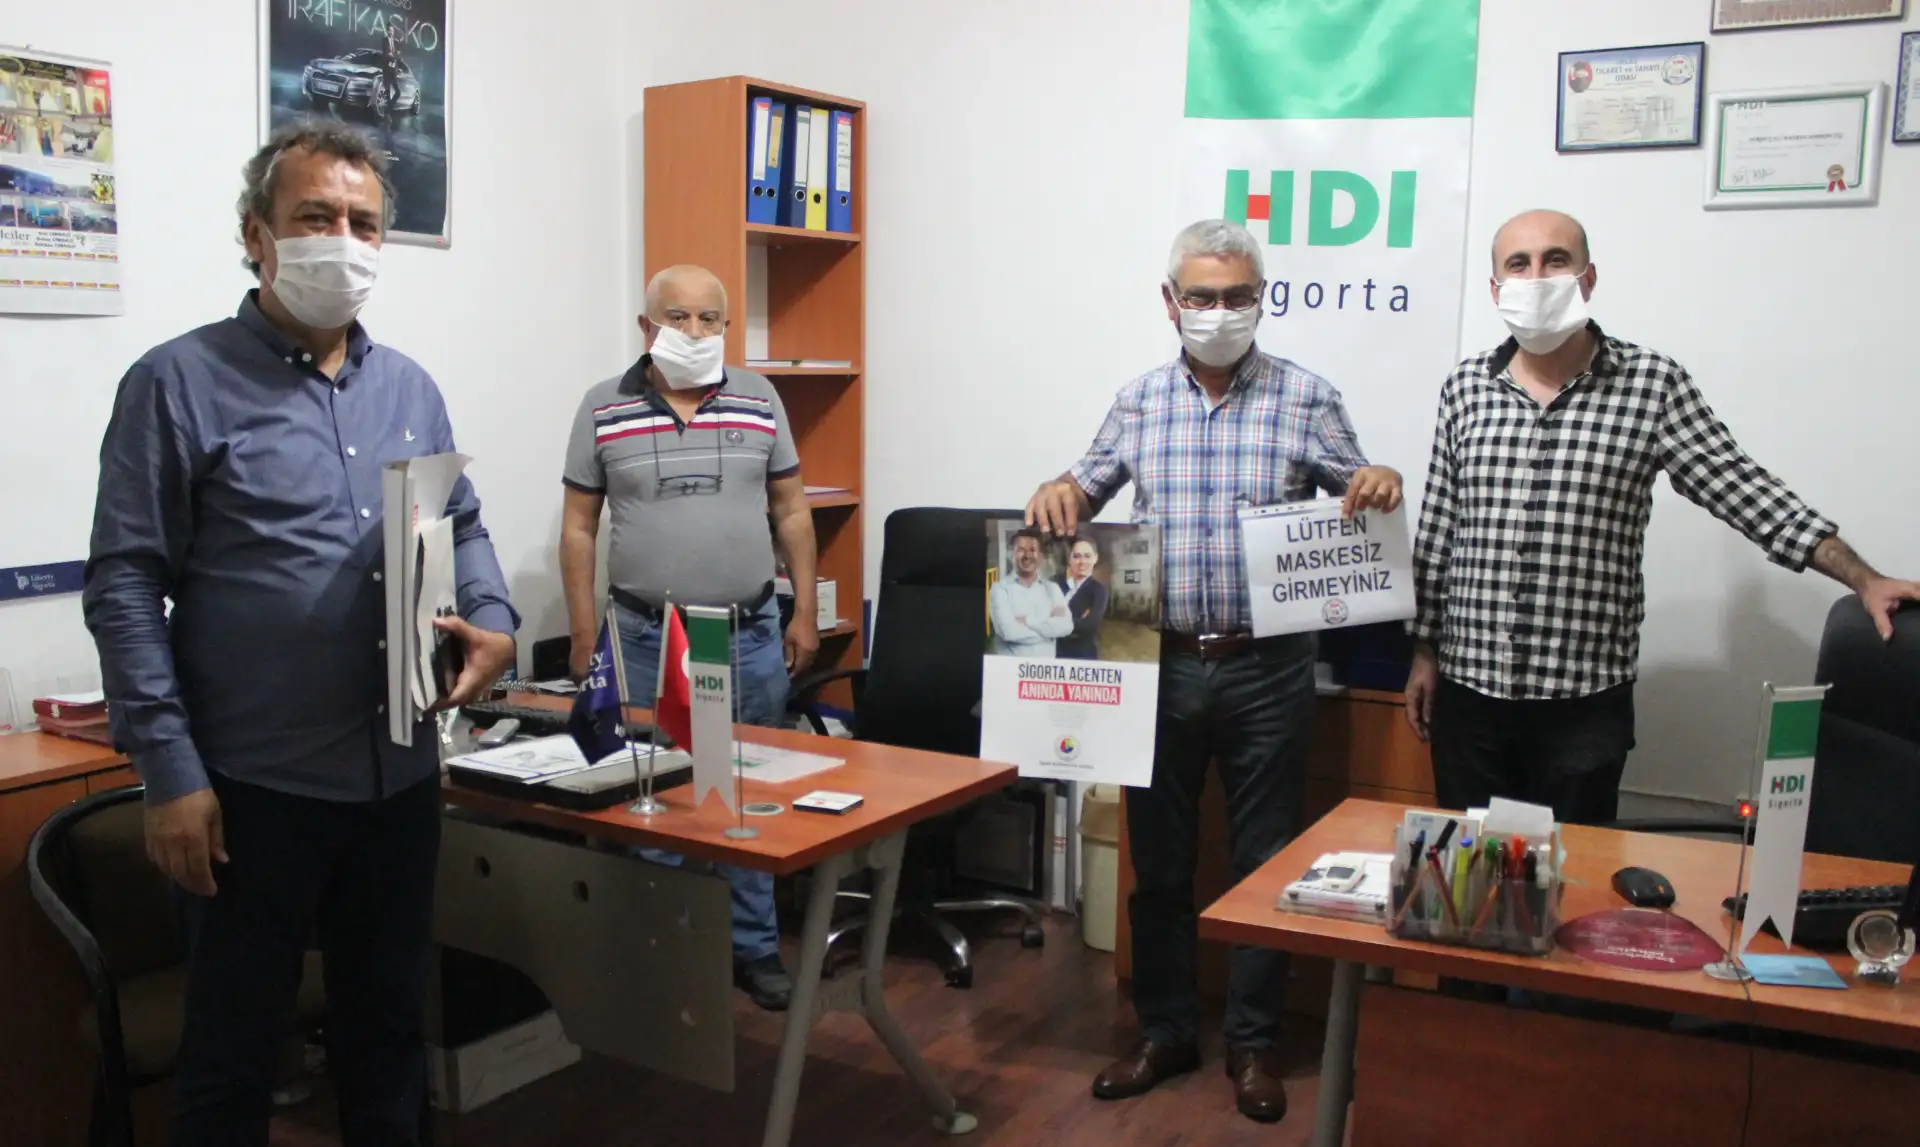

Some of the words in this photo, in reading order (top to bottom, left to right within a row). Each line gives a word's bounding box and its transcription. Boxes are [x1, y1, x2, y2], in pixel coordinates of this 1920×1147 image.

[1224, 169, 1417, 248] HDI
[1286, 516, 1367, 543] LÜTFEN
[1276, 540, 1383, 573] MASKESİZ
[1272, 568, 1393, 603] GİRMEYİNİZ
[695, 675, 724, 691] HDI
[1018, 662, 1066, 680] SİGORTA
[1069, 667, 1122, 684] ACENTEN
[1021, 683, 1064, 700] ANINDA
[1067, 686, 1118, 703] YANINDA
[1770, 774, 1805, 794] HDI
